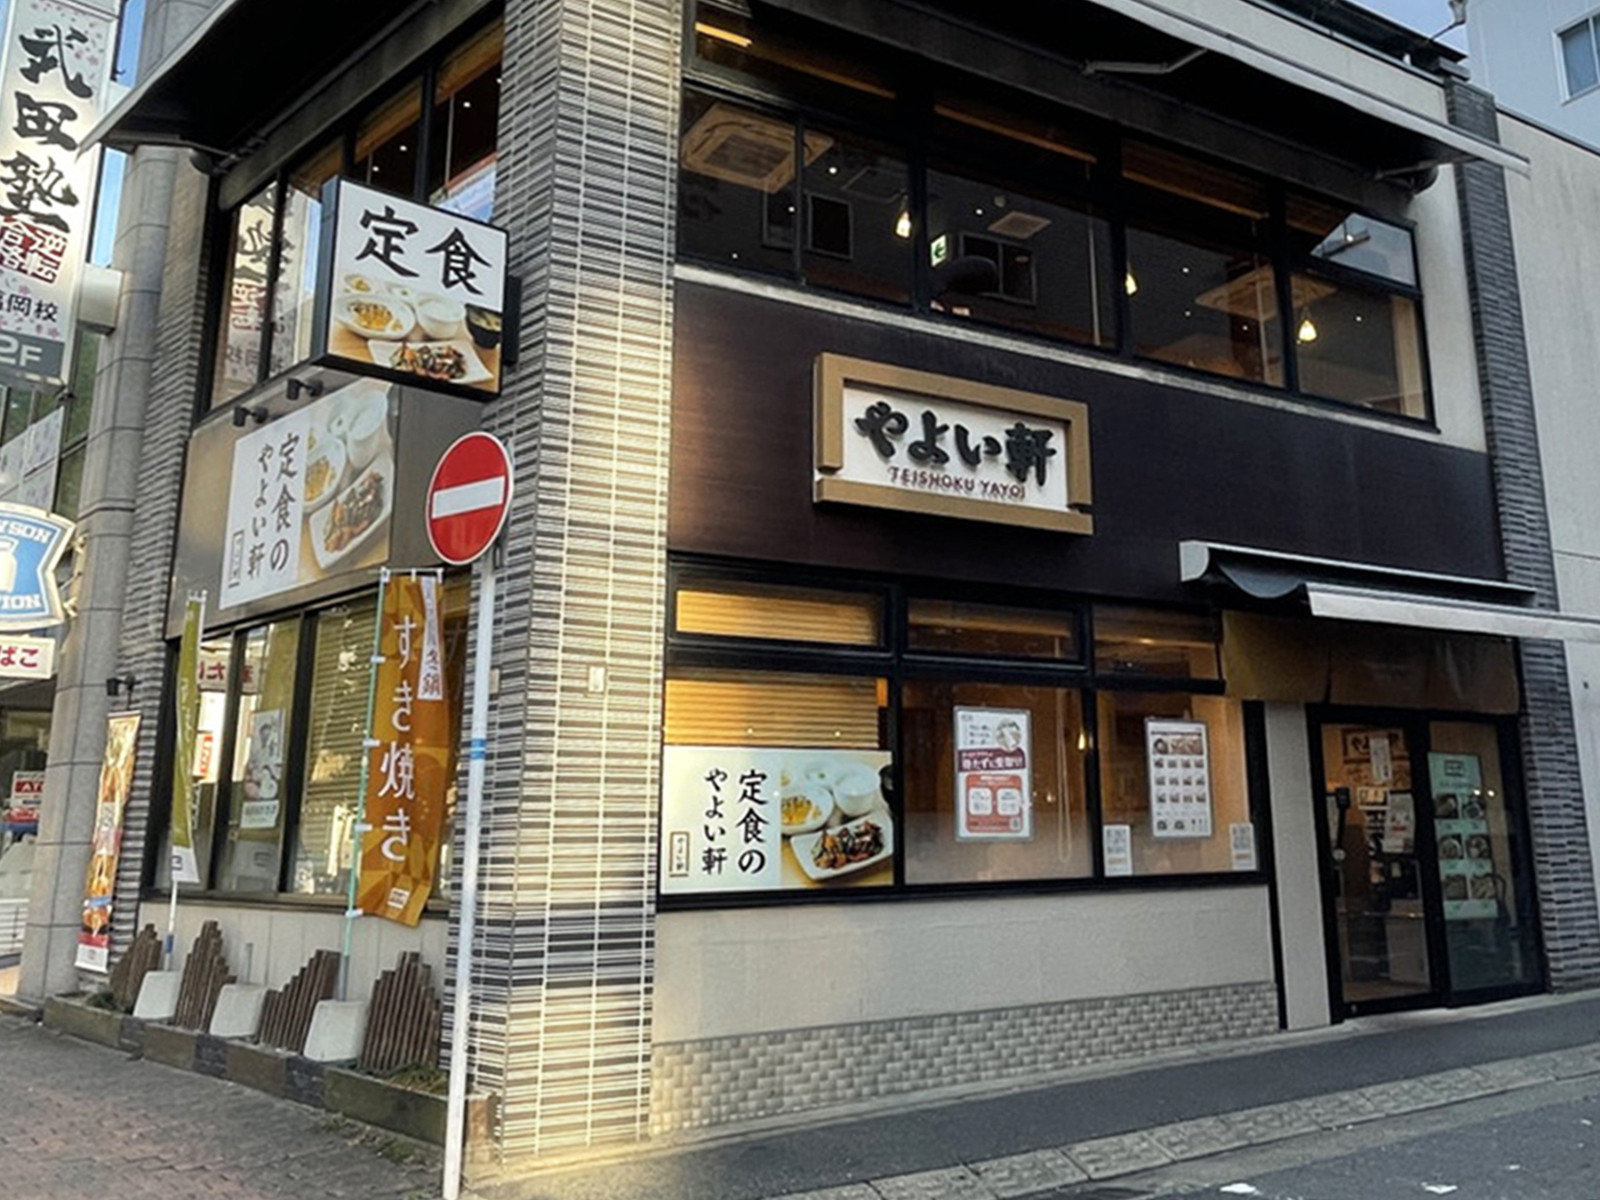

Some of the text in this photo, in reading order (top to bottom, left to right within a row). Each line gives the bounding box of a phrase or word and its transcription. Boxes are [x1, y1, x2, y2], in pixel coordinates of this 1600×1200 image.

[0, 24, 94, 233] 武田塾
[355, 205, 493, 297] 定食
[0, 334, 43, 367] 2F
[855, 400, 1057, 487] やよい軒
[889, 466, 1026, 499] TEISHOKU YAYOI
[248, 443, 274, 579] やよい軒
[270, 432, 300, 571] 定食の
[378, 615, 414, 861] すき焼き
[702, 767, 729, 876] やよい軒
[736, 769, 769, 875] 定食の
